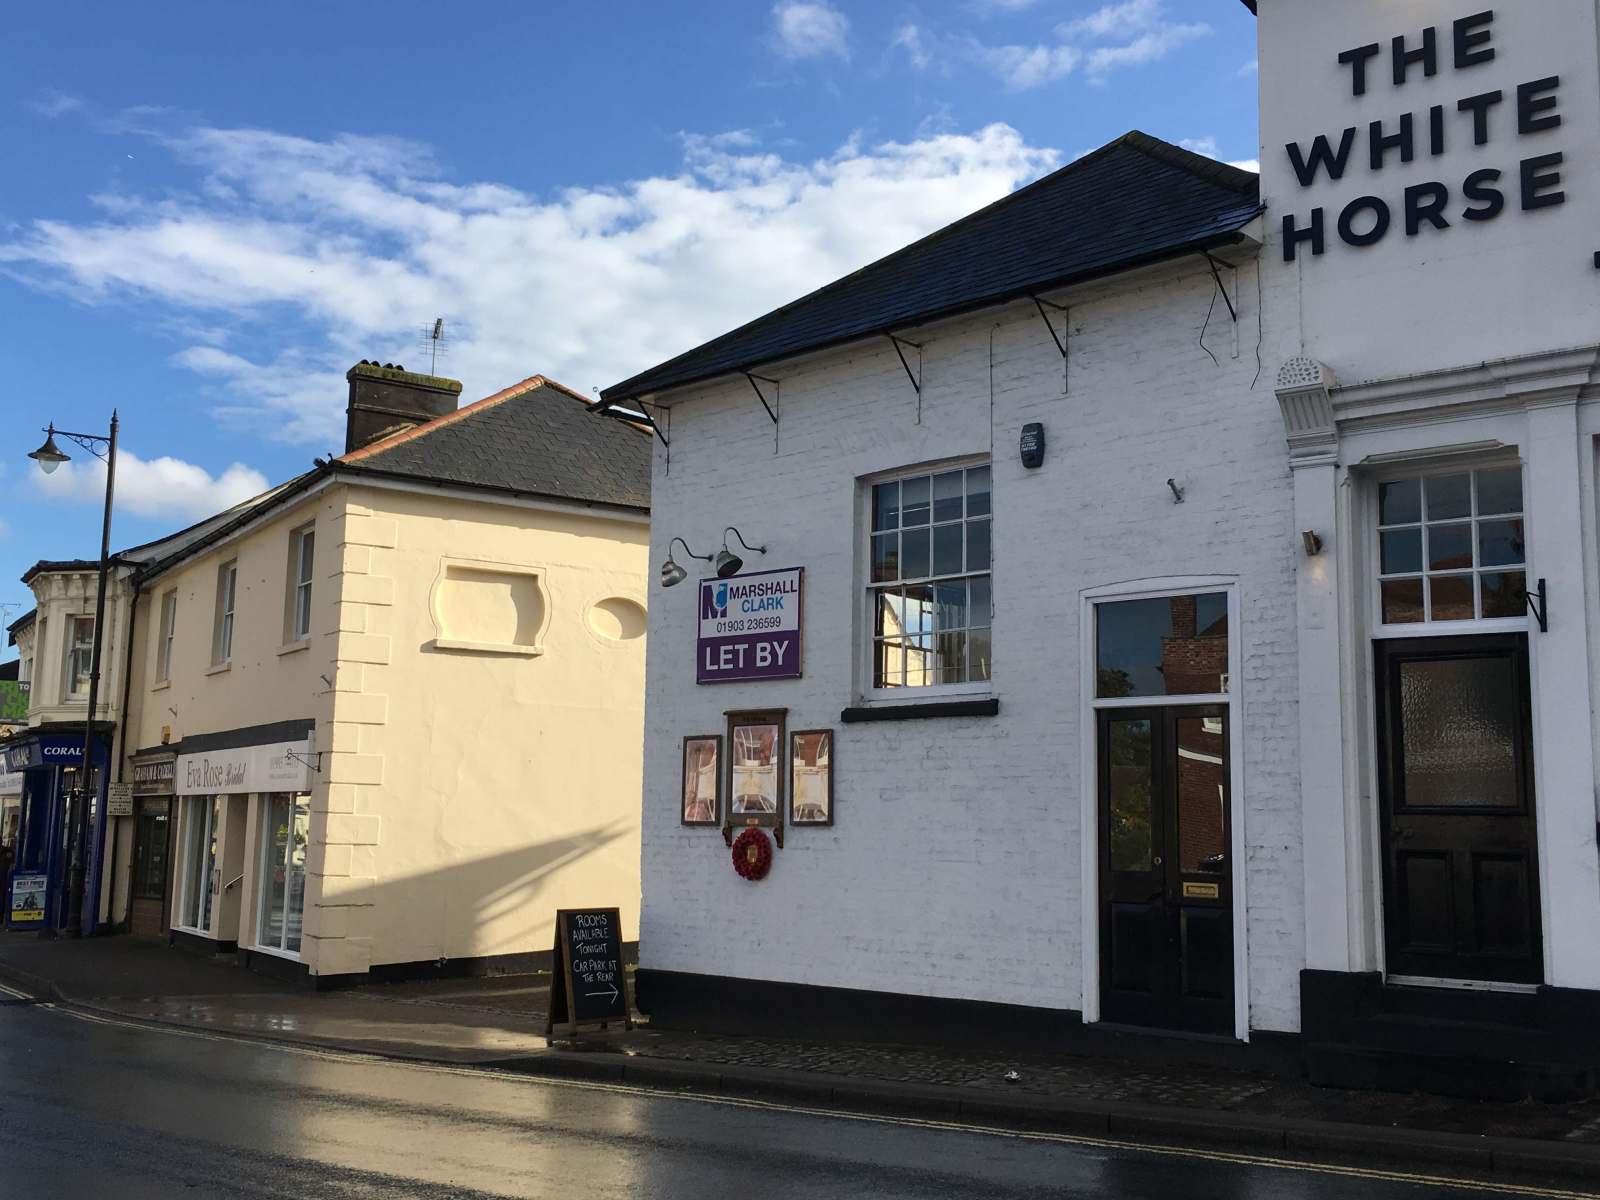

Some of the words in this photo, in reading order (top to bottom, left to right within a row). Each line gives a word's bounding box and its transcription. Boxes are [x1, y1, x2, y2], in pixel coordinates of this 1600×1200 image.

[1338, 10, 1495, 96] THE
[1285, 75, 1561, 187] WHITE
[1282, 151, 1565, 262] HORSE
[729, 579, 798, 600] MARSHALL
[741, 596, 784, 613] CLARK
[716, 619, 745, 633] 01903
[747, 616, 781, 631] 236599
[705, 643, 749, 671] LET
[756, 640, 789, 667] BY
[43, 747, 82, 756] CORAL
[187, 760, 201, 788] Eva
[203, 759, 223, 788] Rose
[575, 914, 608, 928] ROOMS
[572, 927, 609, 942] AVAILABLE
[575, 942, 608, 956] TONIGHT
